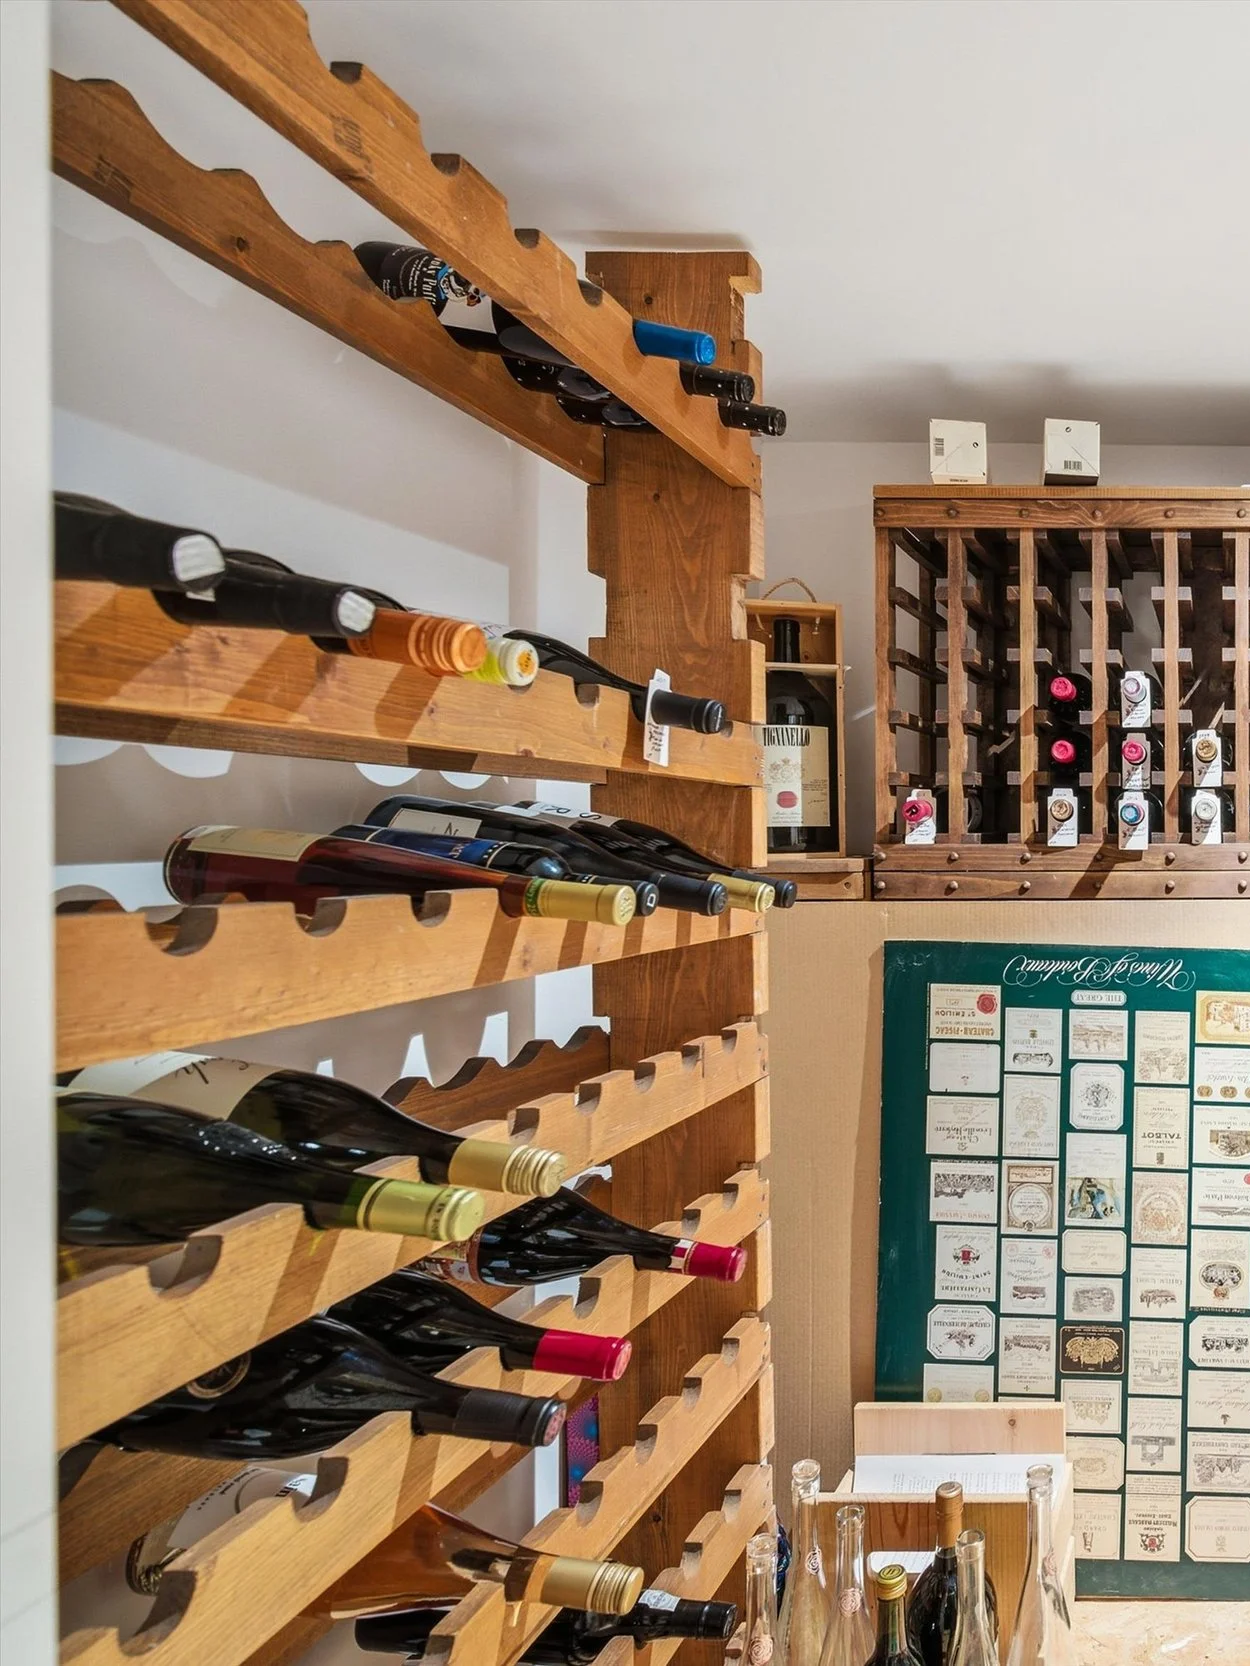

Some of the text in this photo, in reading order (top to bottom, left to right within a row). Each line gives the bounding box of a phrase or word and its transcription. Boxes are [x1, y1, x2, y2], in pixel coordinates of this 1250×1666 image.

[762, 726, 811, 747] TIGNANELLO
[1075, 993, 1122, 1003] THE GREAT
[1141, 1131, 1182, 1140] TALBOT
